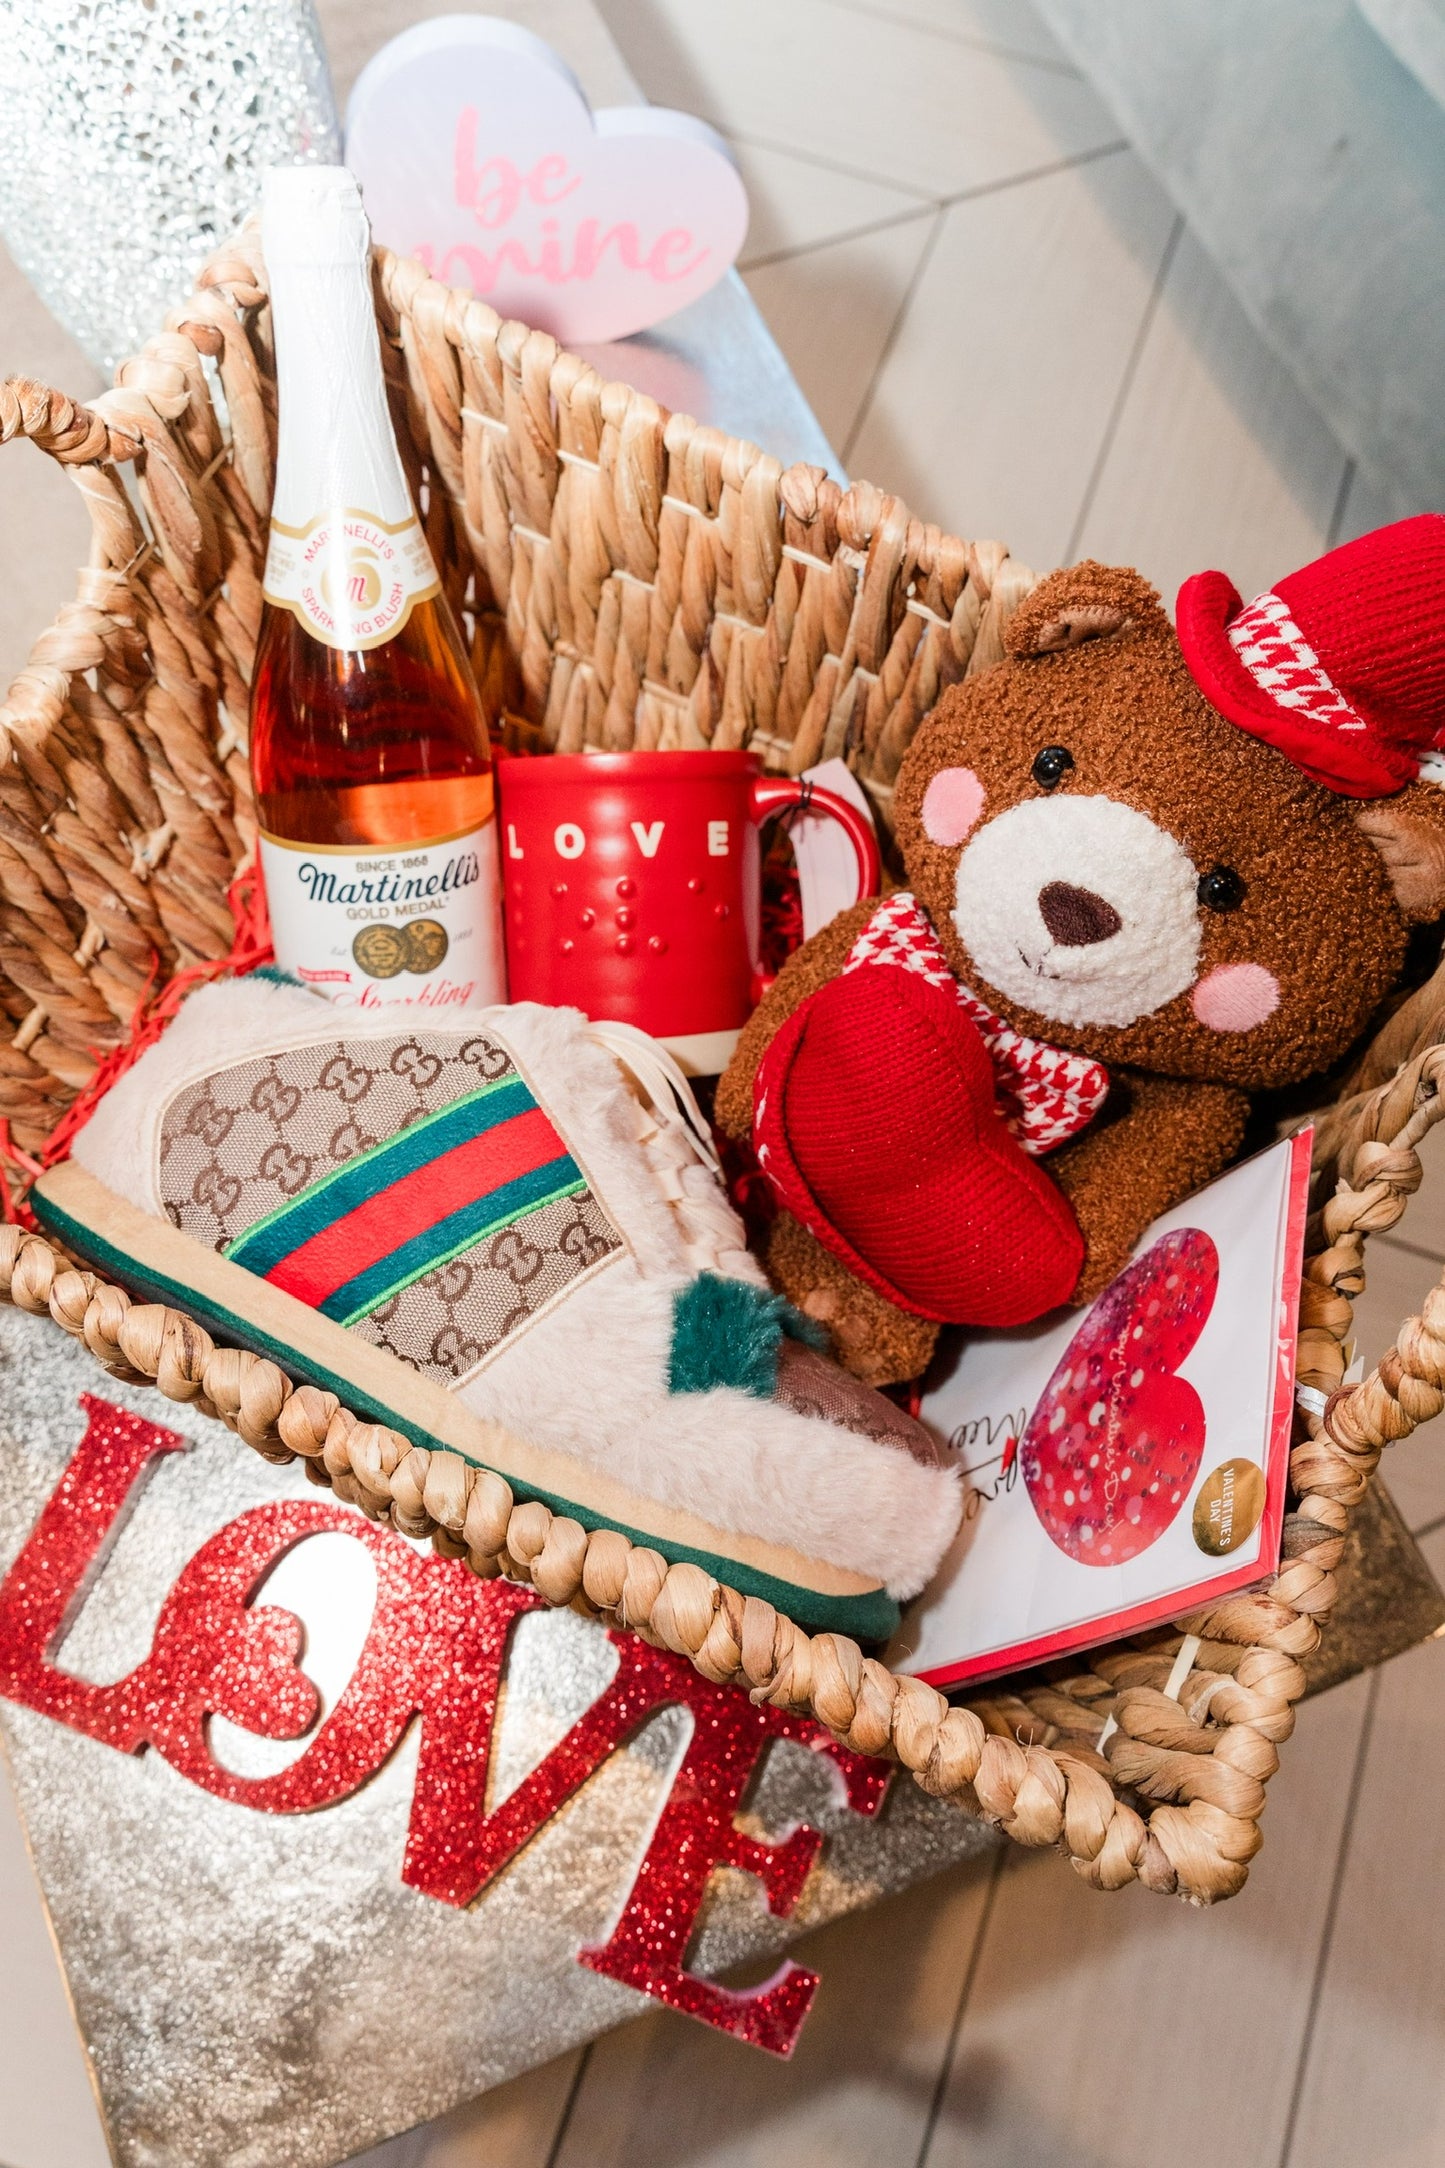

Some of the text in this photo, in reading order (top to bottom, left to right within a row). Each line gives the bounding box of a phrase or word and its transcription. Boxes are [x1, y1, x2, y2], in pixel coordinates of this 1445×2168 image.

[454, 105, 583, 230] be
[412, 217, 712, 296] mine
[304, 524, 394, 563] MARNELLI'S
[302, 582, 404, 634] SPARKNG BLUSH
[506, 820, 730, 861] LOVE
[356, 855, 429, 873] SINCE 1868
[346, 906, 390, 920] GOLD
[1208, 1498, 1220, 1524] DAY
[1219, 1467, 1235, 1546] VALENTINE'S
[0, 1392, 895, 2060] LOVE
